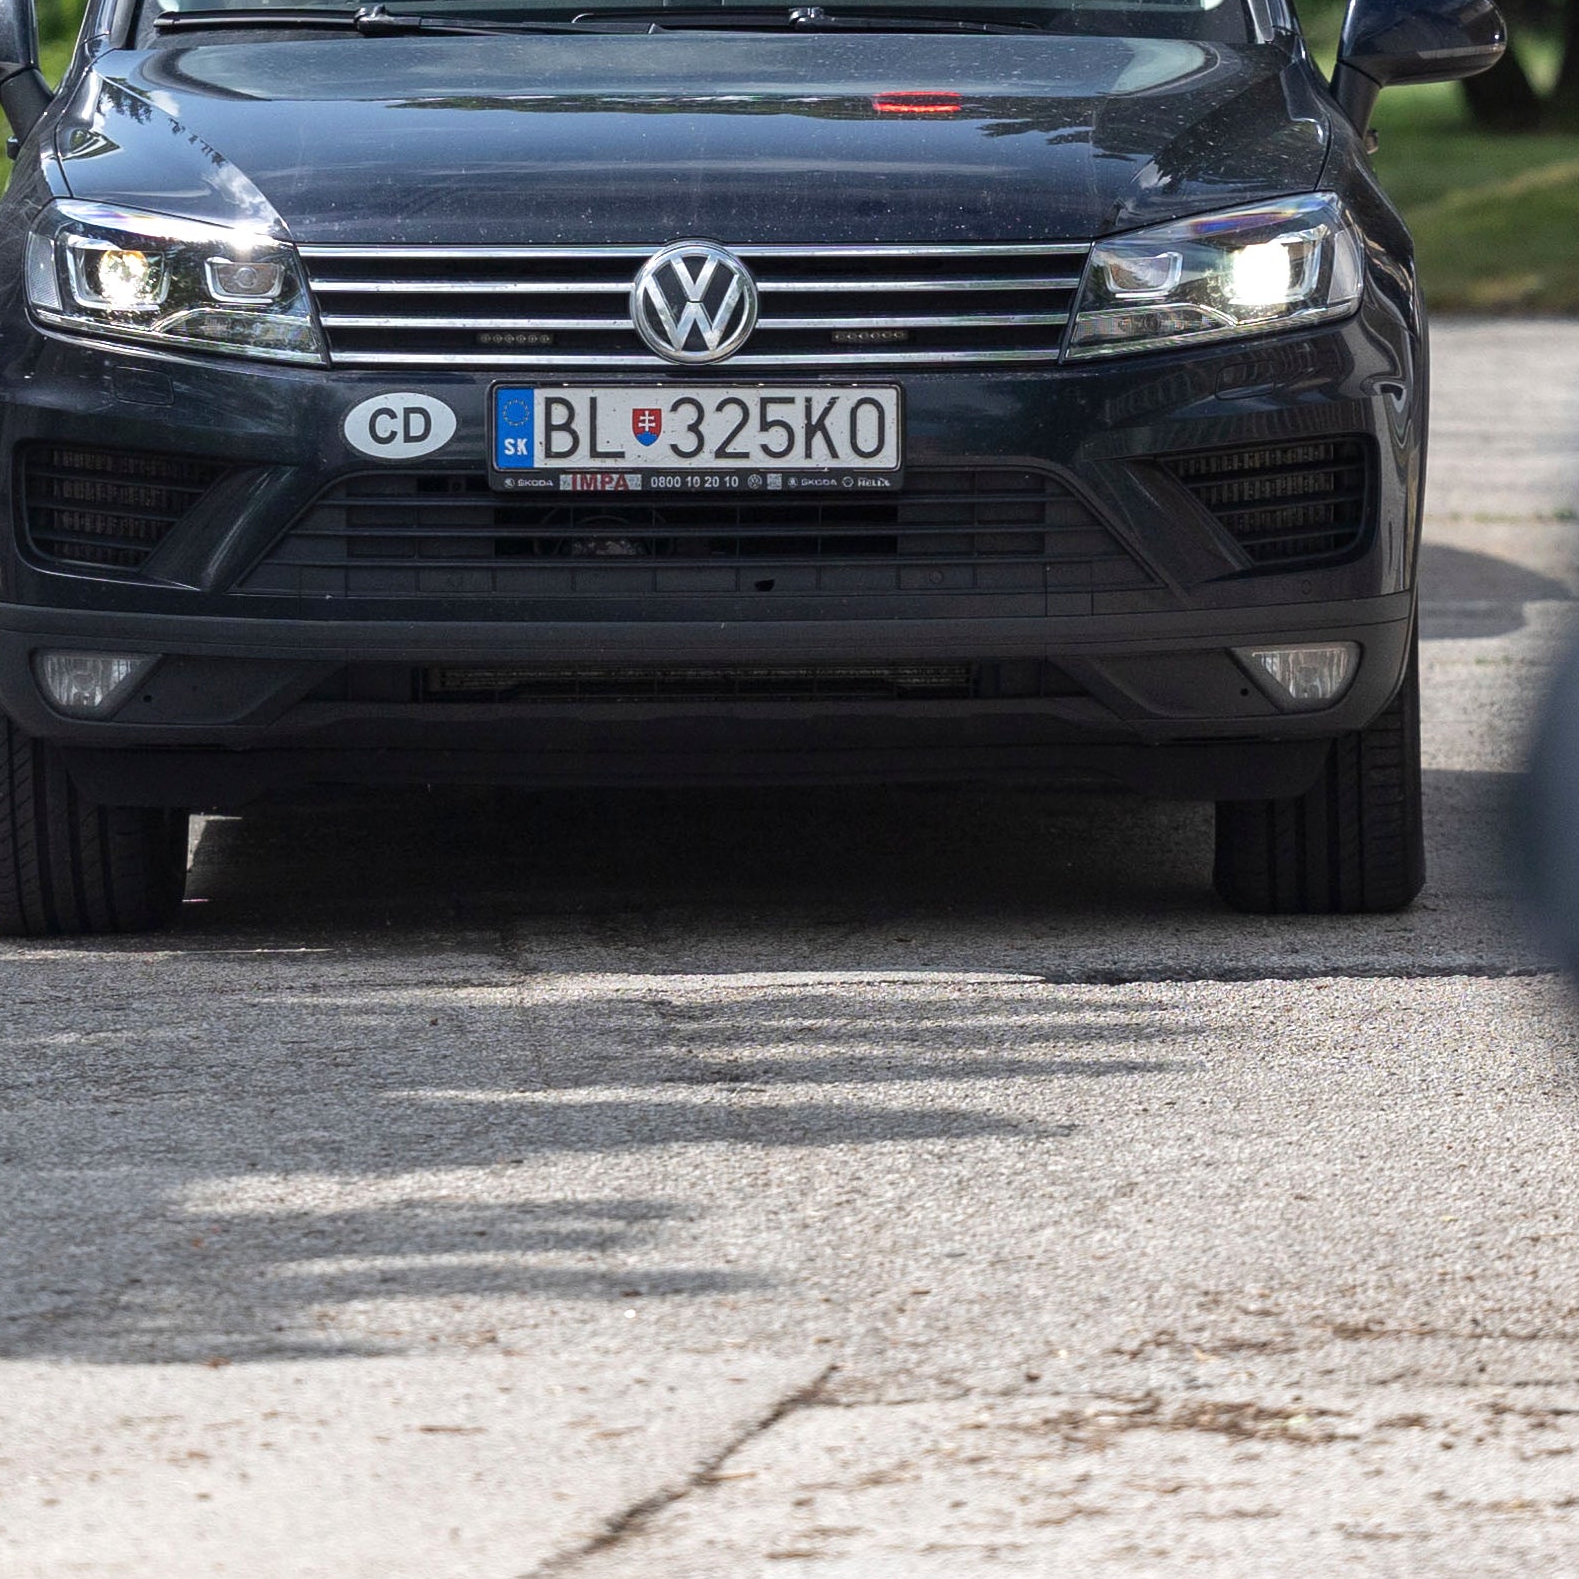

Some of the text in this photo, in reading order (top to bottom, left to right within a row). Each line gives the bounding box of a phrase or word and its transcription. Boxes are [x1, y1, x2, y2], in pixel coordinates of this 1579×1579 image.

[368, 406, 432, 445] CD
[544, 396, 626, 459] BL
[504, 438, 528, 456] SK
[571, 472, 630, 491] IMPA
[650, 476, 681, 488] 0800
[685, 476, 701, 488] 10
[704, 476, 720, 488] 20
[724, 476, 739, 488] 10
